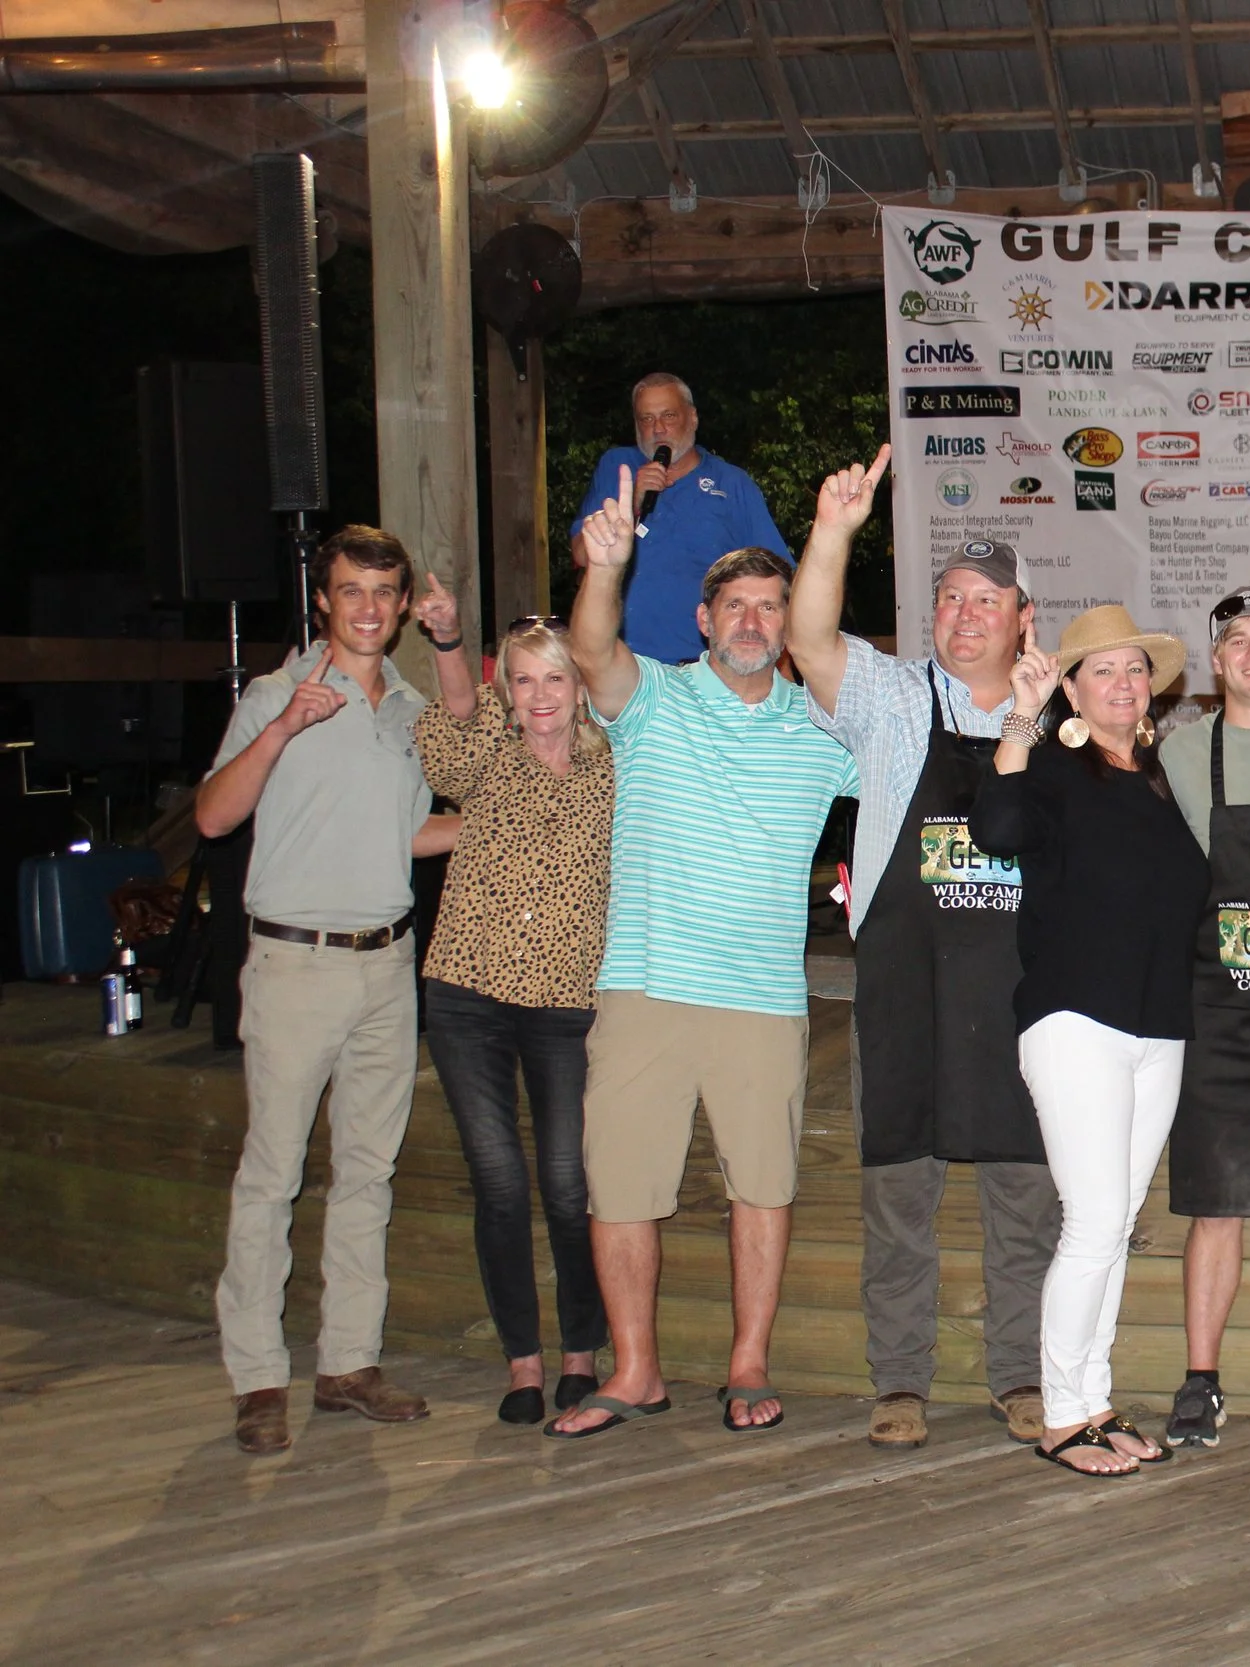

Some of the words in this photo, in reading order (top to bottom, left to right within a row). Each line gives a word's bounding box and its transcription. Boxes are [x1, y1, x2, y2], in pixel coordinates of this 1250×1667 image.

[1001, 221, 1181, 263] GULF
[922, 244, 962, 262] AWF
[902, 298, 924, 312] AG
[926, 297, 979, 314] CREDIT
[1175, 314, 1239, 322] EQUIPMENT
[1027, 350, 1113, 370] COWIN
[1132, 352, 1213, 365] EQUIPMENT
[907, 395, 918, 410] P
[921, 395, 936, 410] &
[940, 394, 952, 409] R
[957, 393, 1014, 413] Mining
[1219, 408, 1250, 417] FLEET
[1087, 431, 1109, 442] Bass
[925, 435, 986, 457] Airgas
[1012, 443, 1052, 451] ARNOLD
[1088, 441, 1105, 452] Pro
[1087, 449, 1116, 462] Shops
[1181, 459, 1200, 467] PINE
[944, 484, 969, 497] MSI
[1076, 485, 1114, 497] LAND
[999, 495, 1034, 505] MOSSY
[1034, 495, 1056, 505] OAK
[930, 515, 965, 526] Advanced
[966, 515, 1003, 528] Integrated
[1005, 515, 1034, 527] Security
[1149, 516, 1171, 528] Bayou
[1173, 516, 1198, 527] Marine
[930, 529, 962, 540] Alabama
[963, 529, 985, 540] Power
[987, 529, 1021, 542] Company
[1150, 529, 1172, 541] Bayou
[1174, 530, 1206, 540] Concrete
[1150, 542, 1172, 553] Beard
[1174, 542, 1214, 554] Equipment
[1216, 542, 1250, 554] Company
[1025, 556, 1056, 568] truction,
[1058, 556, 1071, 567] LLC
[1168, 556, 1193, 567] Hunter
[1195, 556, 1208, 567] Pro
[1209, 556, 1227, 569] Shop
[1175, 570, 1194, 581] Land
[1195, 571, 1201, 581] &
[1203, 570, 1228, 581] Timber
[1186, 584, 1214, 594] Lumber
[1043, 598, 1081, 609] Generators
[1082, 599, 1089, 608] &
[923, 816, 959, 824] ALABAMA
[932, 884, 978, 897] WILD
[939, 896, 1020, 912] COOK-OFF
